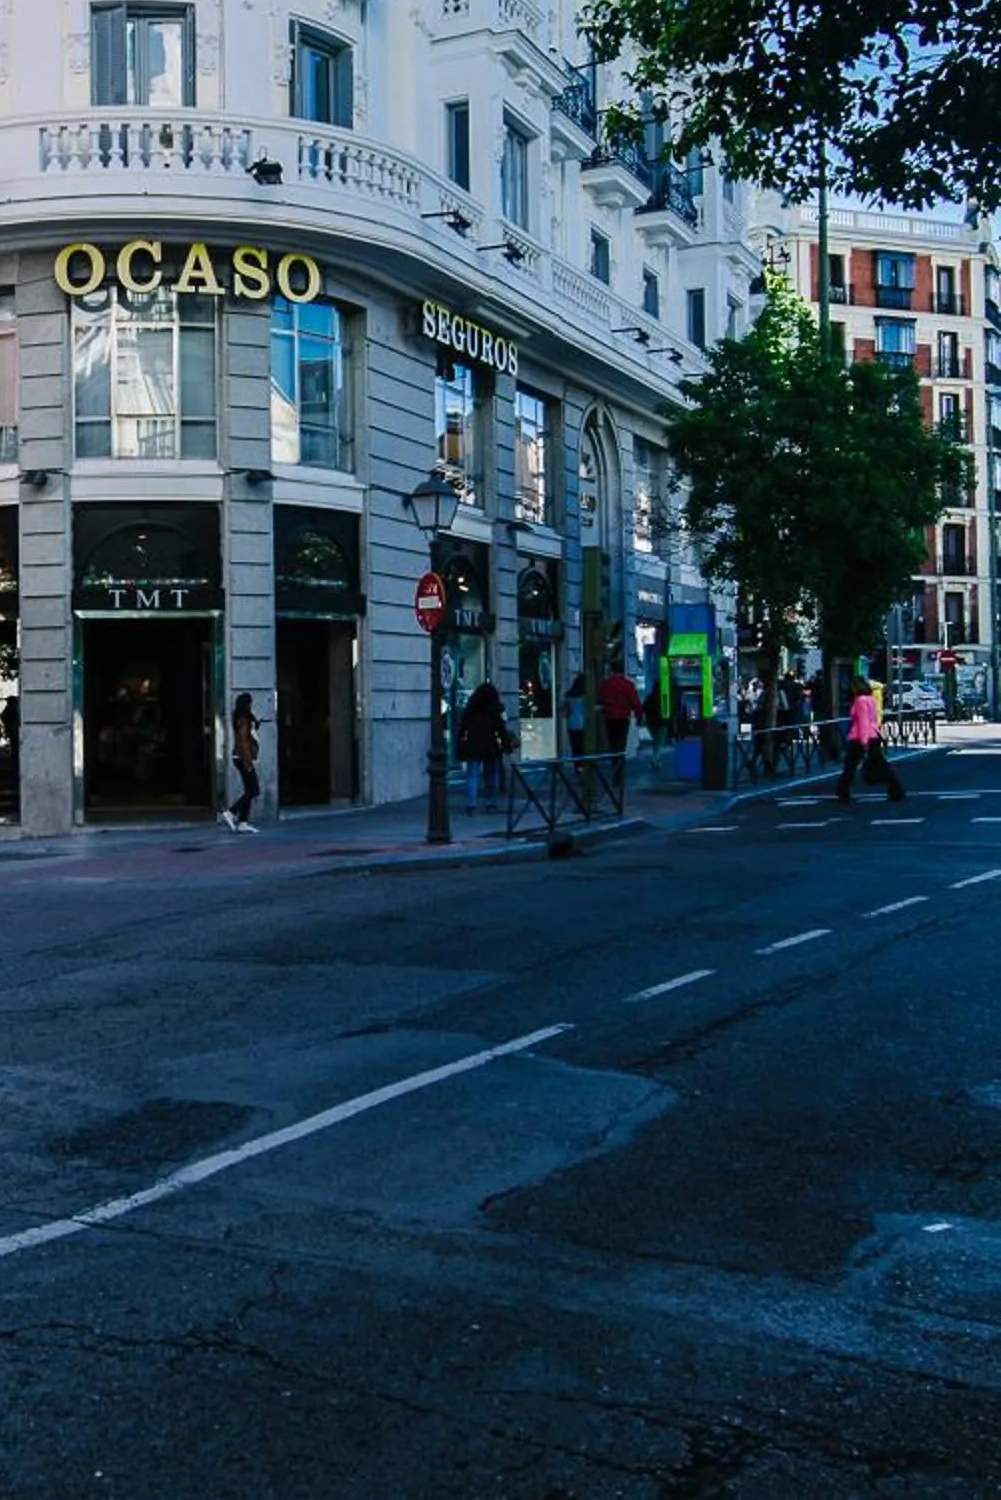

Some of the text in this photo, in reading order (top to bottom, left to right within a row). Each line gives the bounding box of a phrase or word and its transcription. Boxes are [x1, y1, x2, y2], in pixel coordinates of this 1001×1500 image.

[54, 239, 321, 303] OCASO
[423, 299, 518, 377] SEGUROS
[108, 589, 189, 609] TMT
